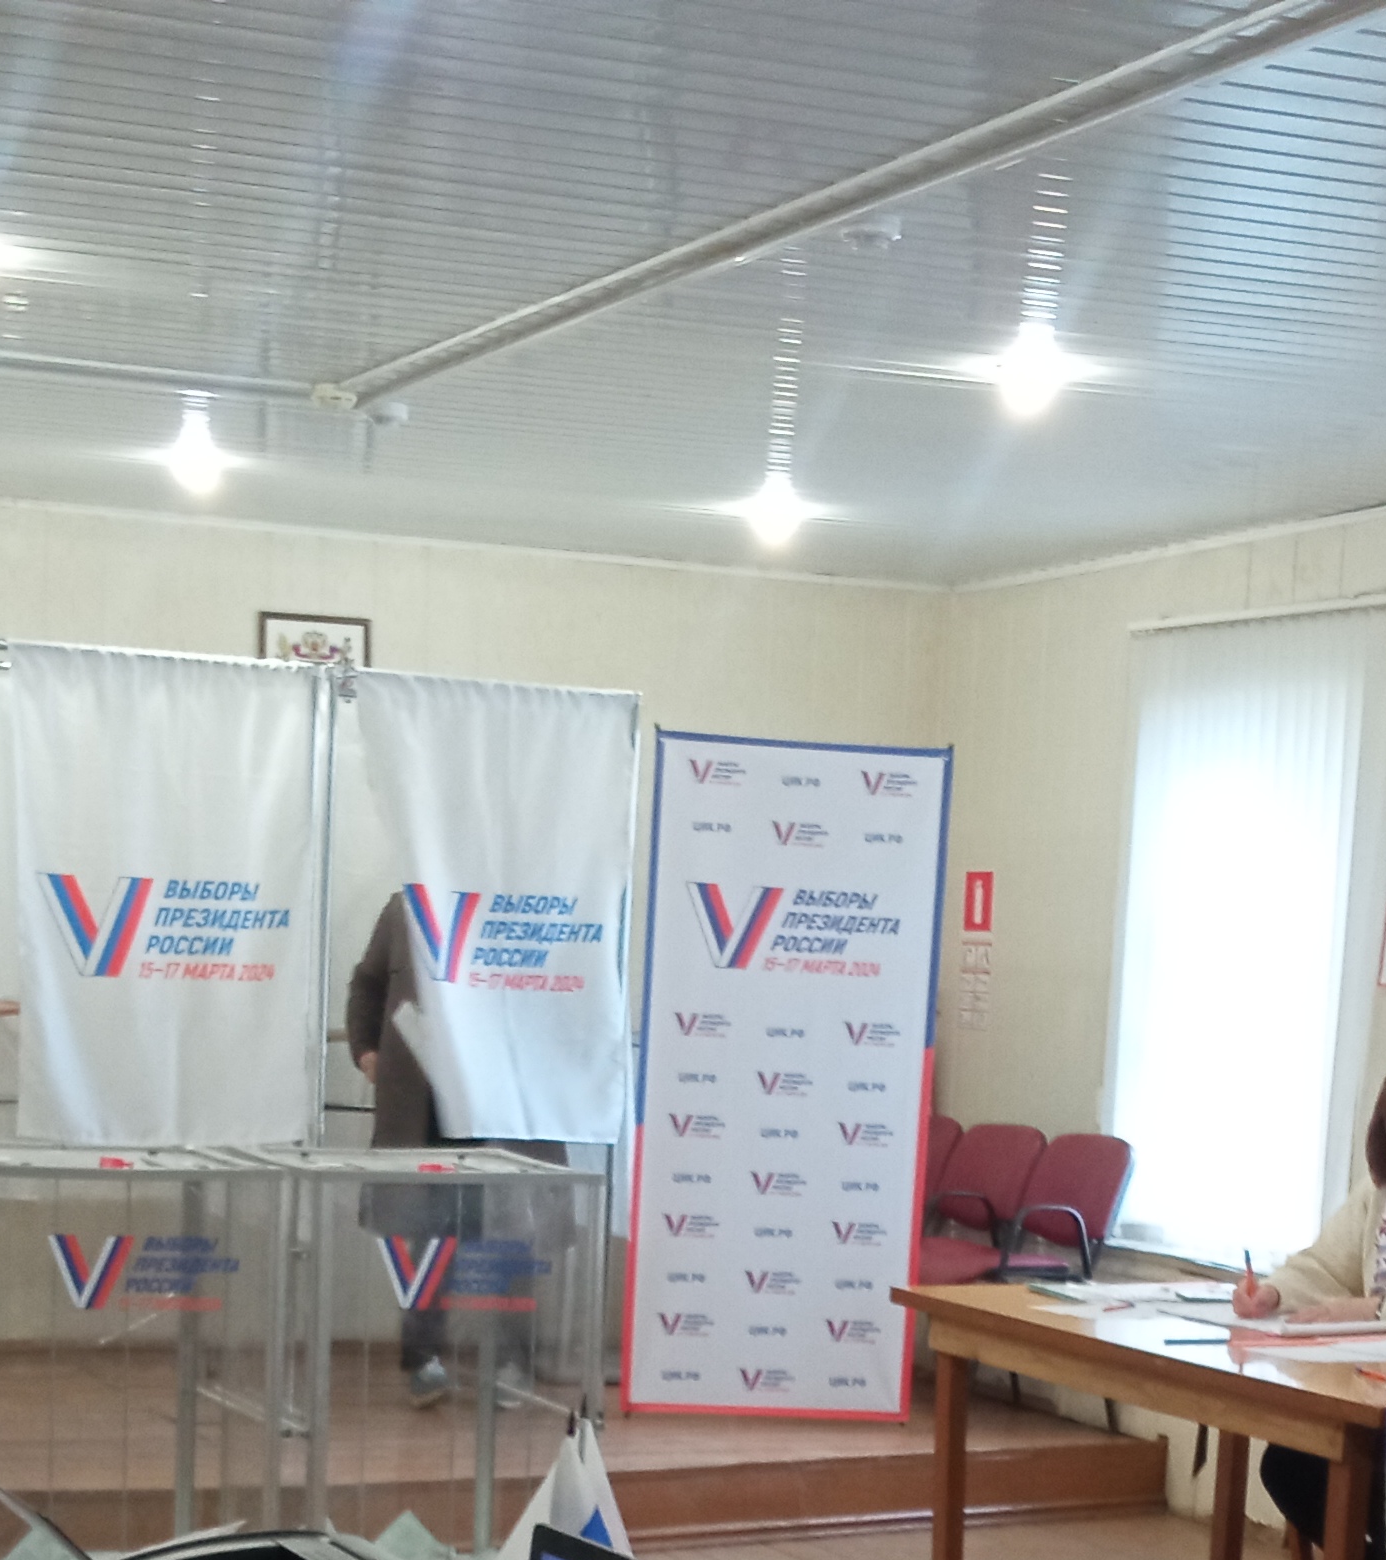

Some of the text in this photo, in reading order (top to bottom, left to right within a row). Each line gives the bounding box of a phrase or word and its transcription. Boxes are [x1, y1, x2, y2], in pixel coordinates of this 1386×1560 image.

[163, 879, 260, 902] ВЫБОРЫ
[793, 889, 878, 910] ВЫБОРЫ
[489, 893, 578, 915] ВЫБОРЫ
[154, 907, 291, 931] ПРЕЗИДЕНТА
[781, 911, 901, 935] ПРЕЗИДЕНТА
[480, 920, 603, 945] ПРЕЗИДЕНТА
[145, 935, 235, 956] РОССИИ
[770, 935, 848, 955] РОССИИ
[470, 947, 550, 968] РОССИИ
[182, 962, 236, 981] МАРТА
[238, 963, 276, 982] 2024
